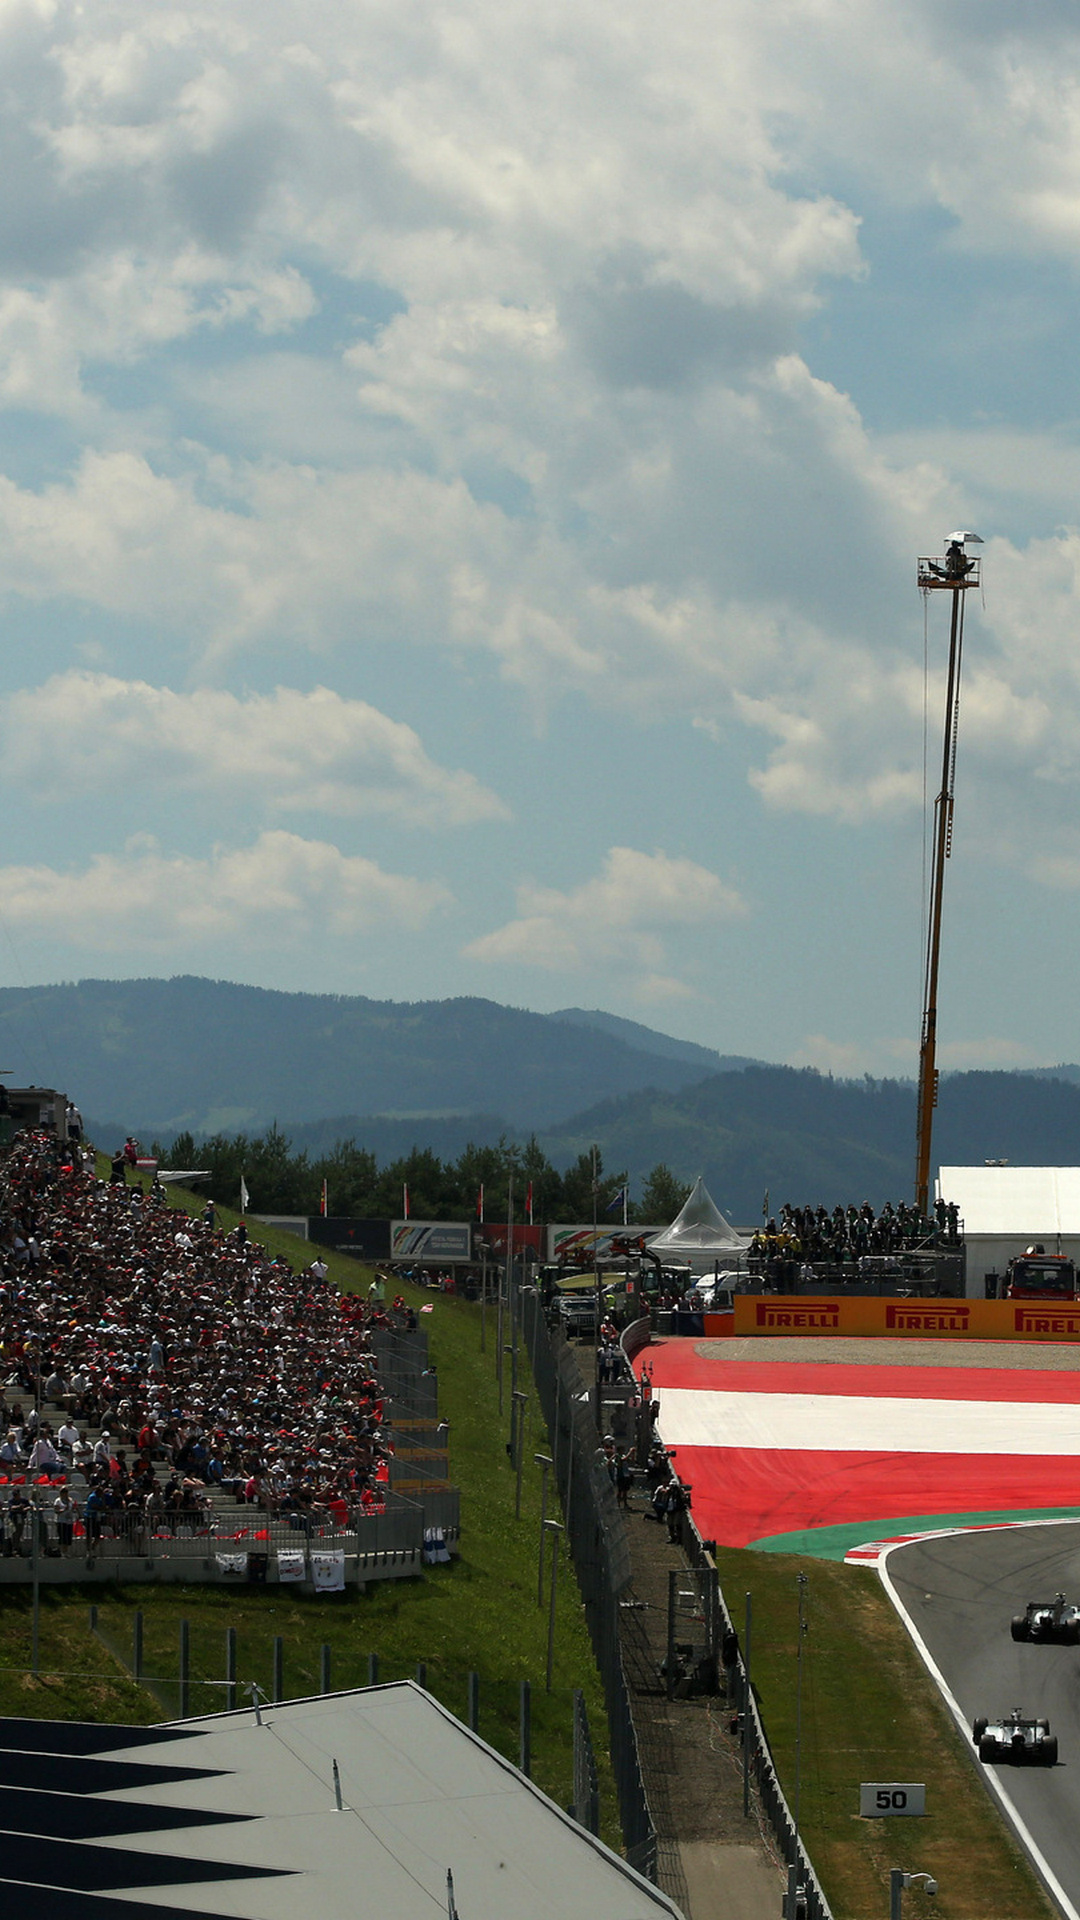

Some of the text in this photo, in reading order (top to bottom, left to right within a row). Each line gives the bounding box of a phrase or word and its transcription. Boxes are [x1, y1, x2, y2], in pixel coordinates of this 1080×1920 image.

[756, 1303, 840, 1327] PIRELLI
[886, 1305, 970, 1330] PIRELLI
[876, 1791, 907, 1809] 50
